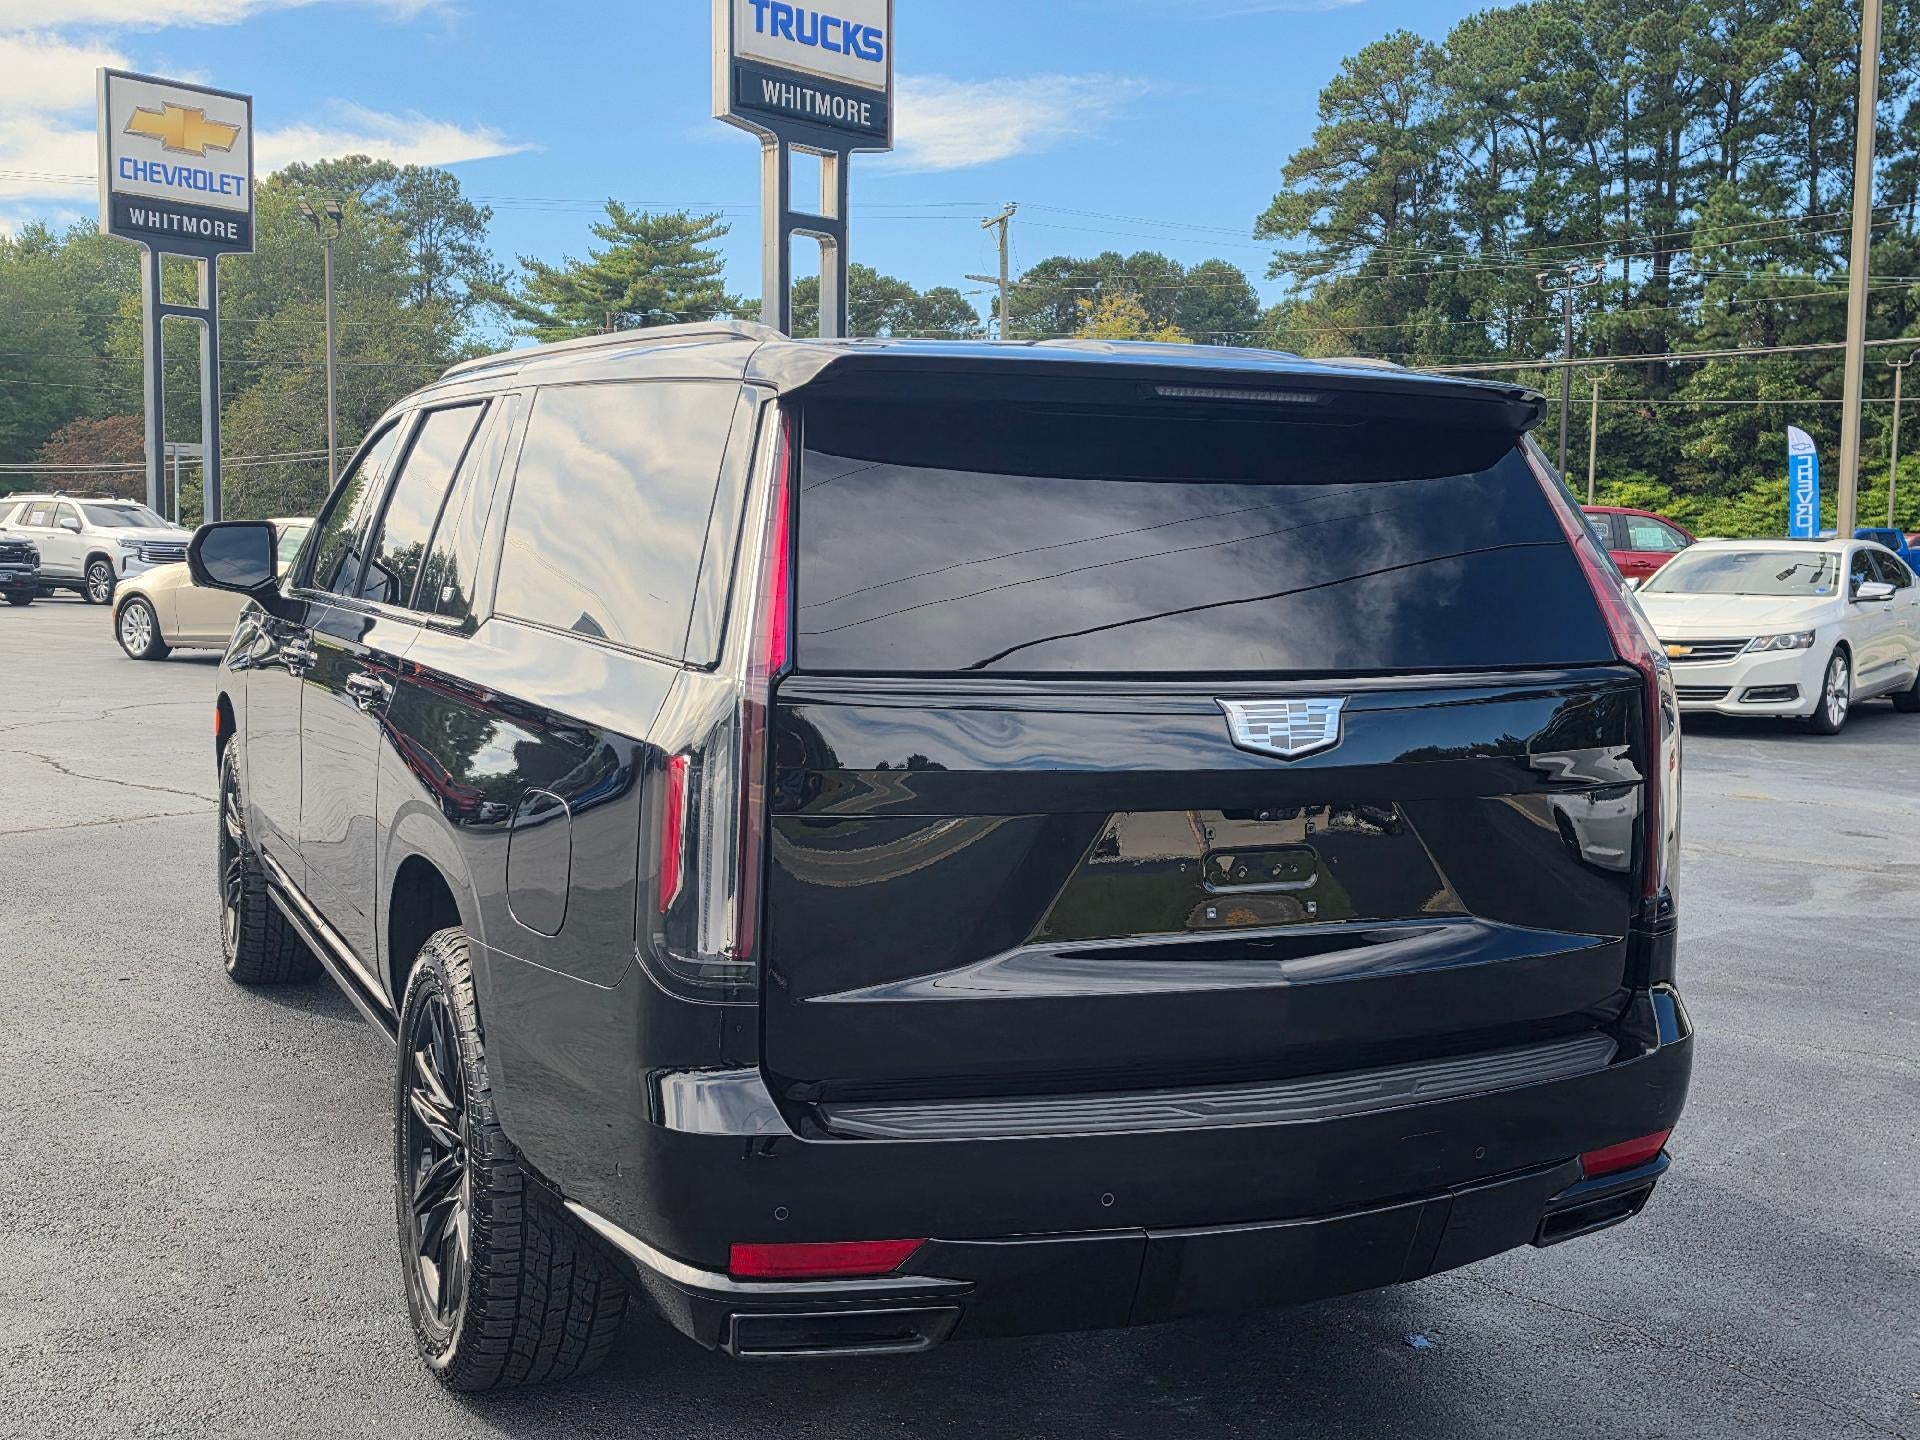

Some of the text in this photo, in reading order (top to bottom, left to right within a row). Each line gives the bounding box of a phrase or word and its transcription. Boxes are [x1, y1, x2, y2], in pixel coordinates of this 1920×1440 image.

[749, 0, 883, 62] TRUCKS
[762, 79, 871, 126] WHITMORE
[119, 157, 245, 196] CHEVROLET
[129, 207, 238, 239] WHITMORE
